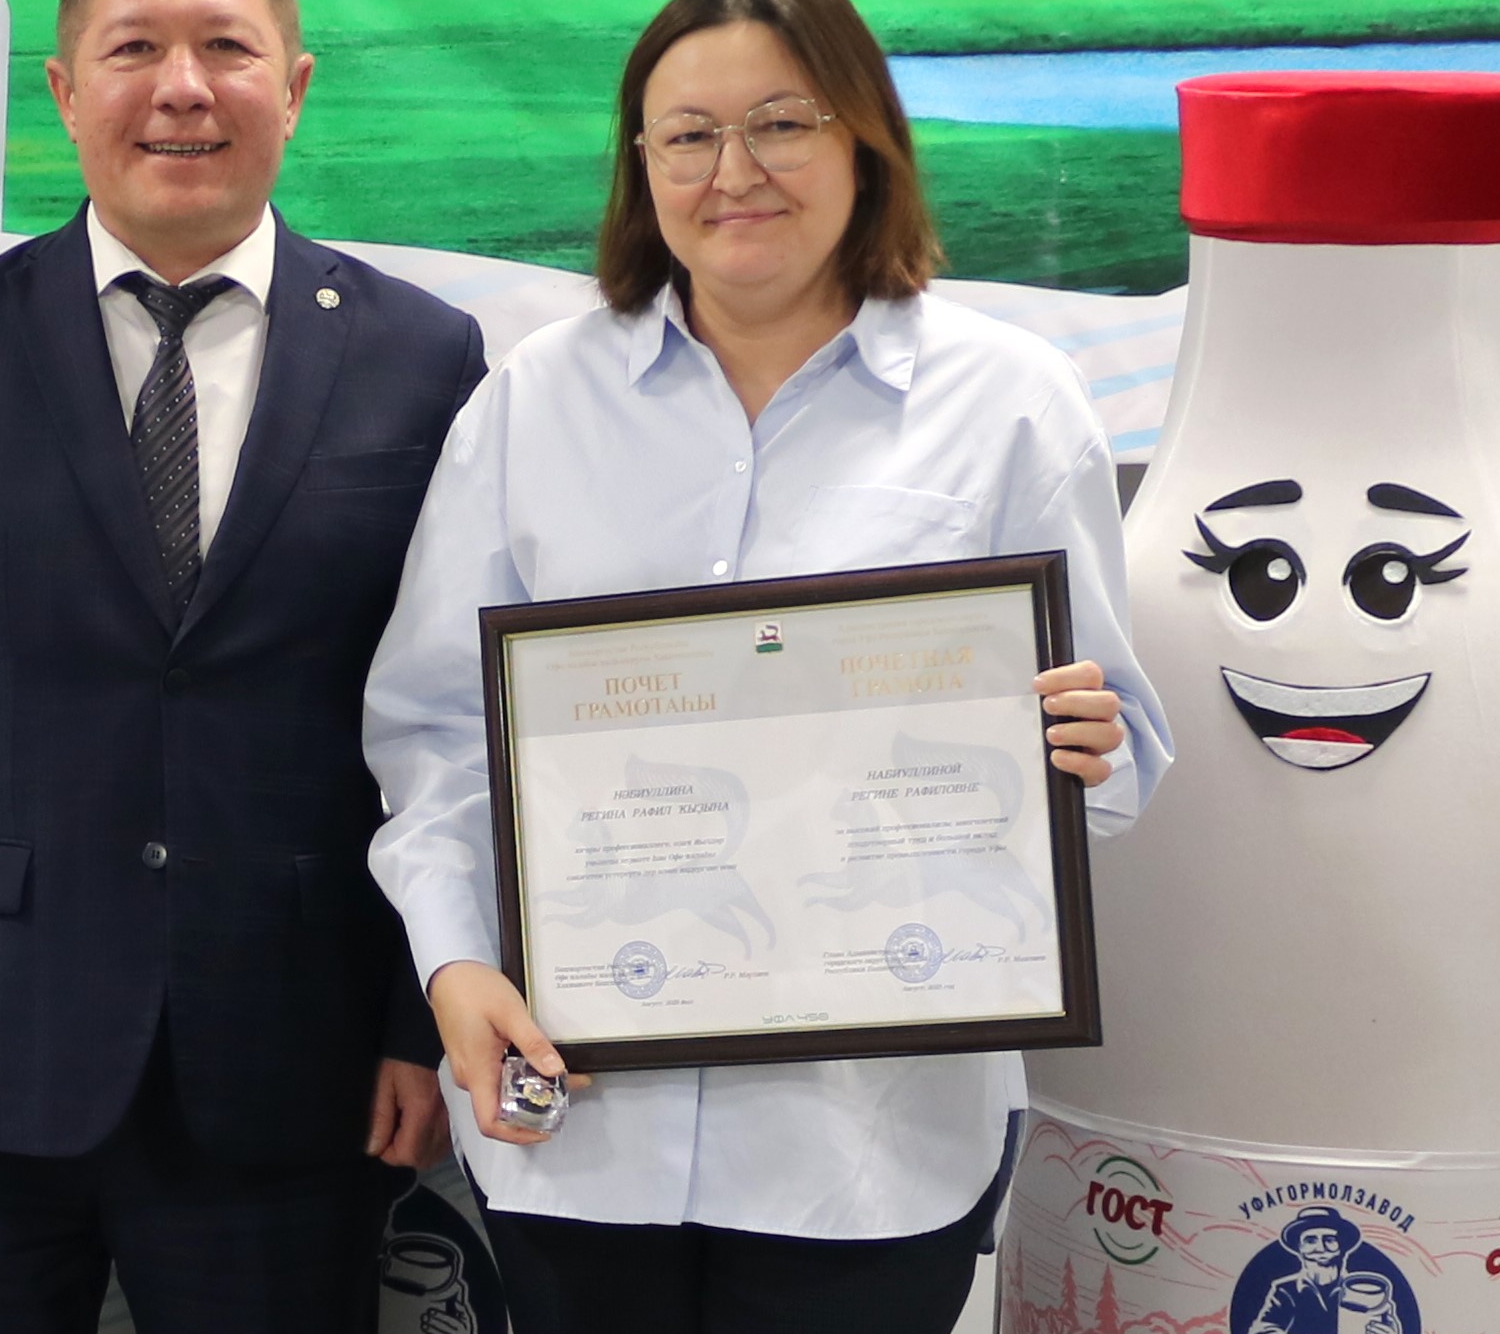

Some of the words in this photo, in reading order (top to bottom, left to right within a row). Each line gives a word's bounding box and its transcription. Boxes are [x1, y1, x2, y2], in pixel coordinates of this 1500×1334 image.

[604, 672, 683, 696] ПОЧЕТ
[1085, 1180, 1174, 1237] ГОСТ
[1238, 1181, 1416, 1234] УФАГОРМОЛЗАВОД
